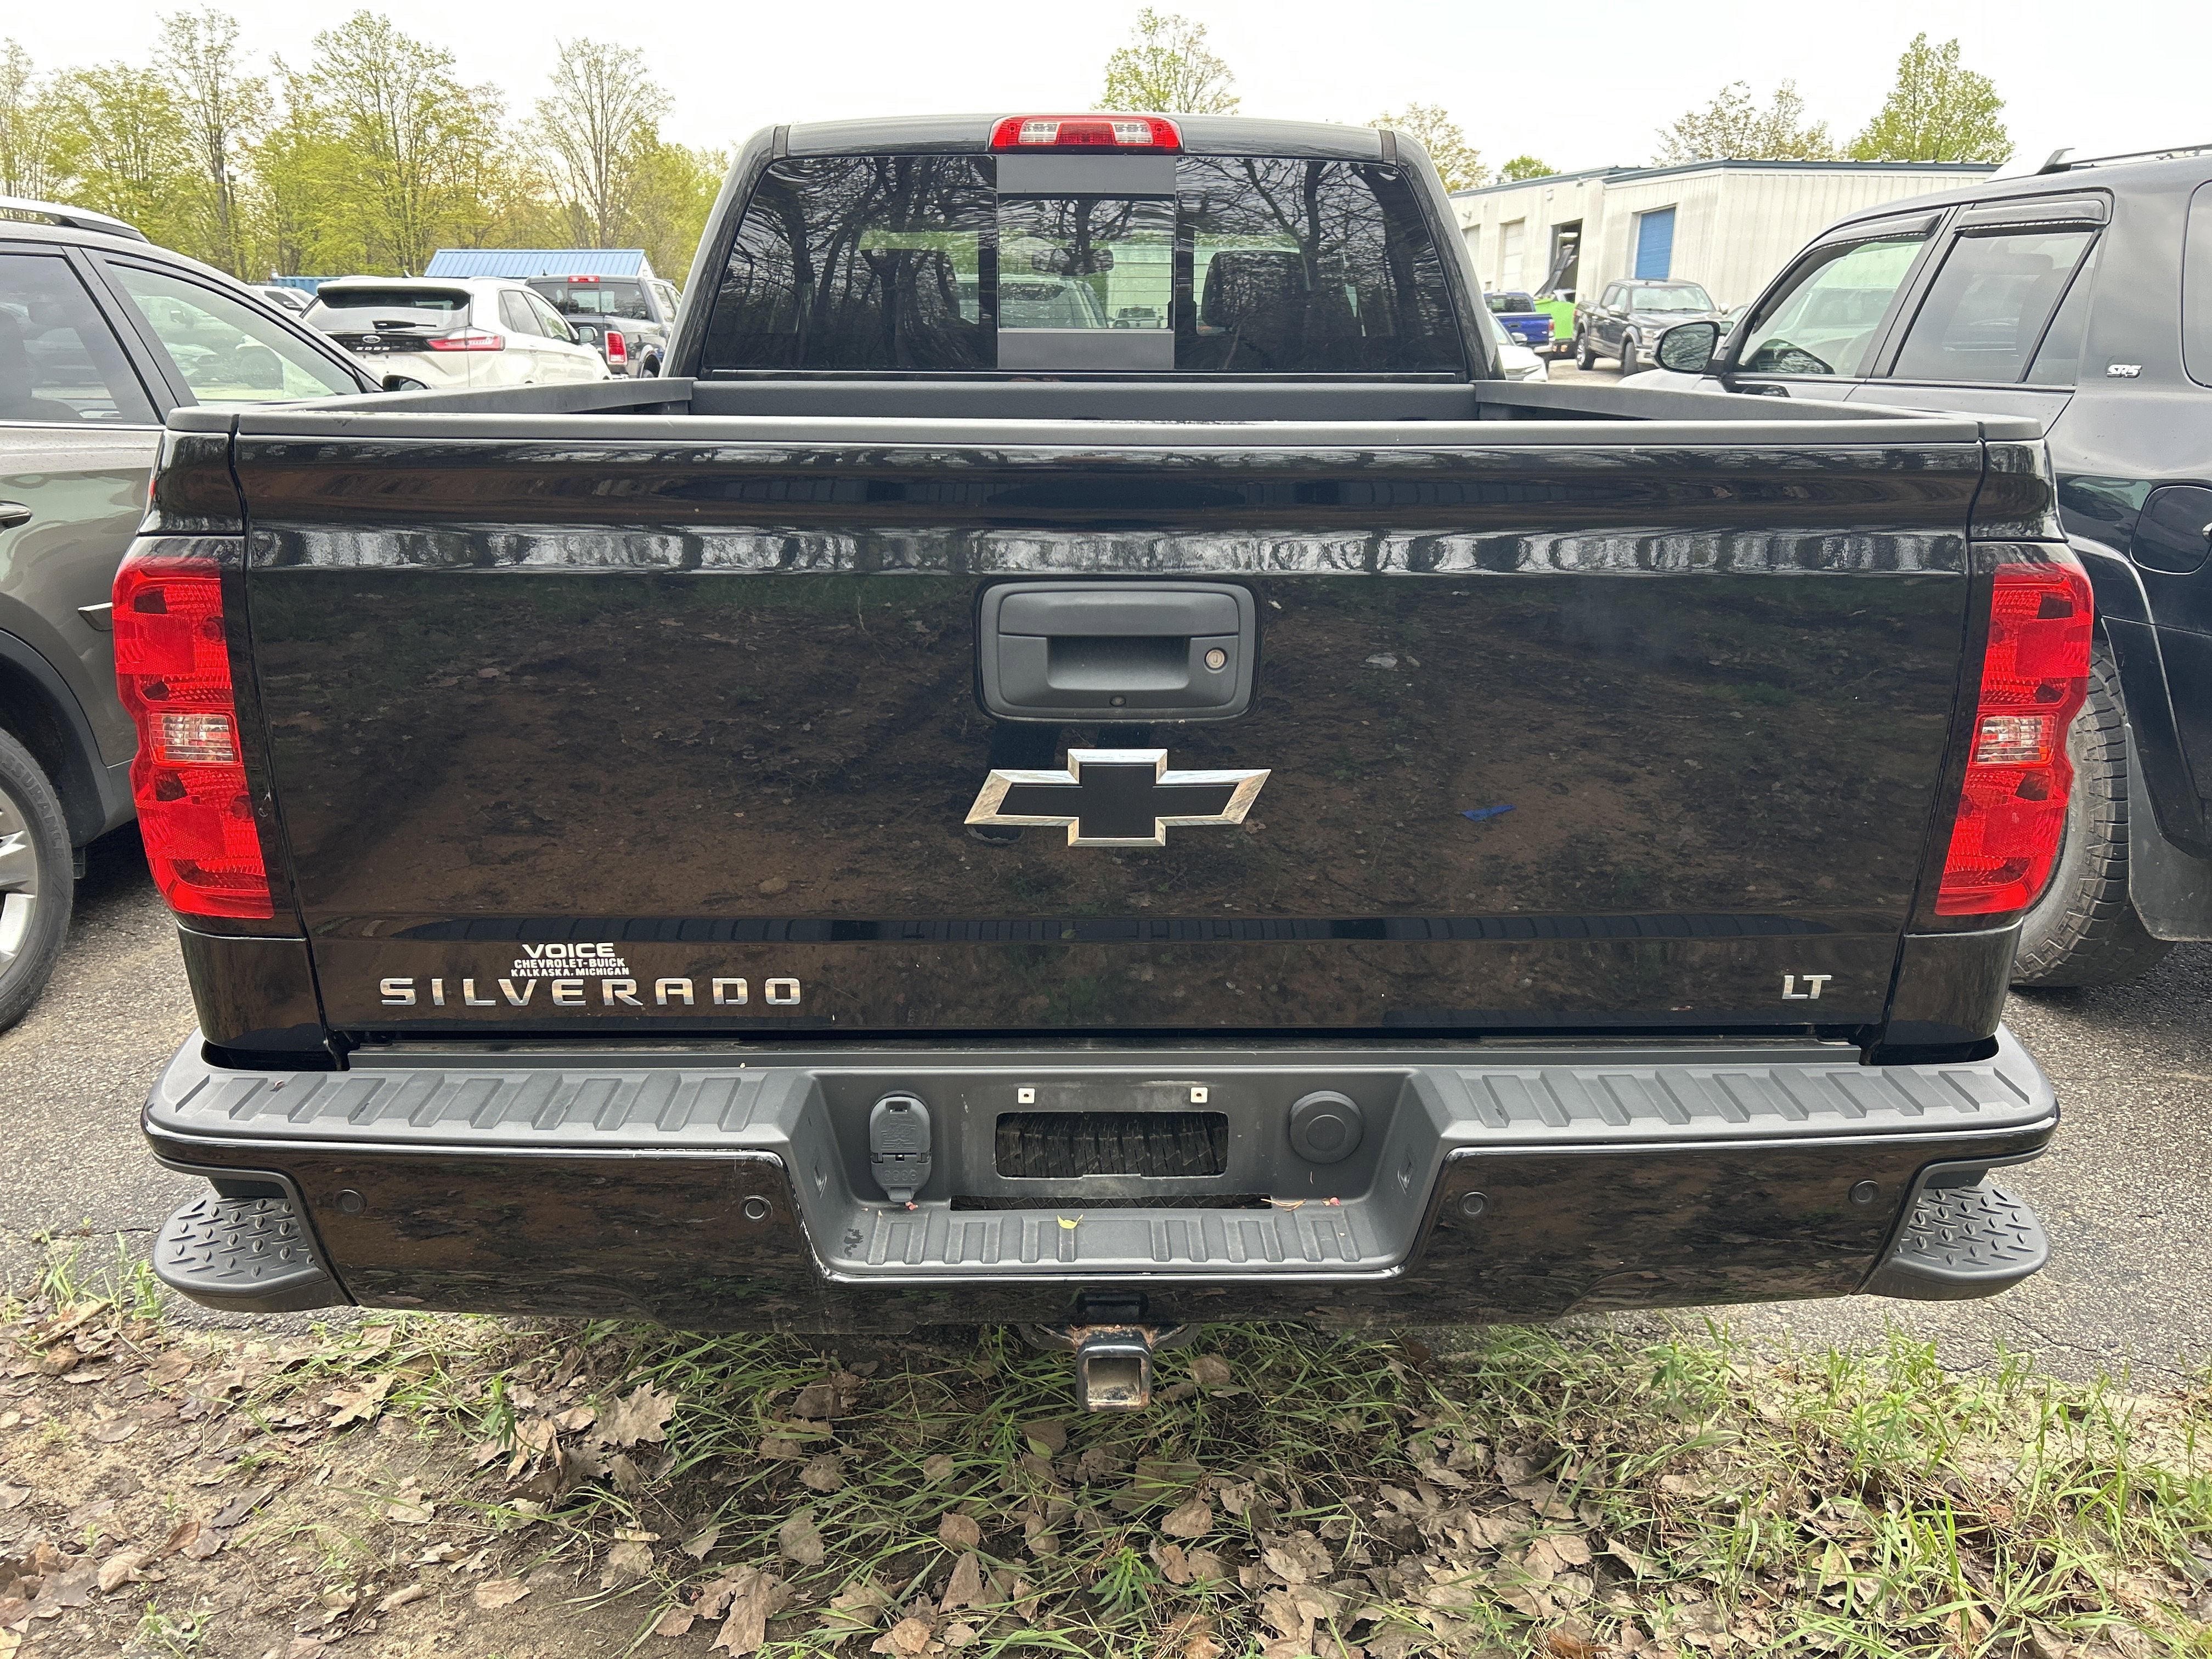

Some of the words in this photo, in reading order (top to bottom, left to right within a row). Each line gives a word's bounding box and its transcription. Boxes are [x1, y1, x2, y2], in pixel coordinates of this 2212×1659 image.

[2107, 364, 2142, 377] SR5
[0, 748, 65, 859] SSURANCE
[522, 943, 616, 958] VOICE
[514, 958, 625, 968] CHEVROLET-BUICK
[575, 967, 629, 976] MICHIGAN
[380, 978, 802, 1007] SILVERADO
[1781, 974, 1832, 999] LT
